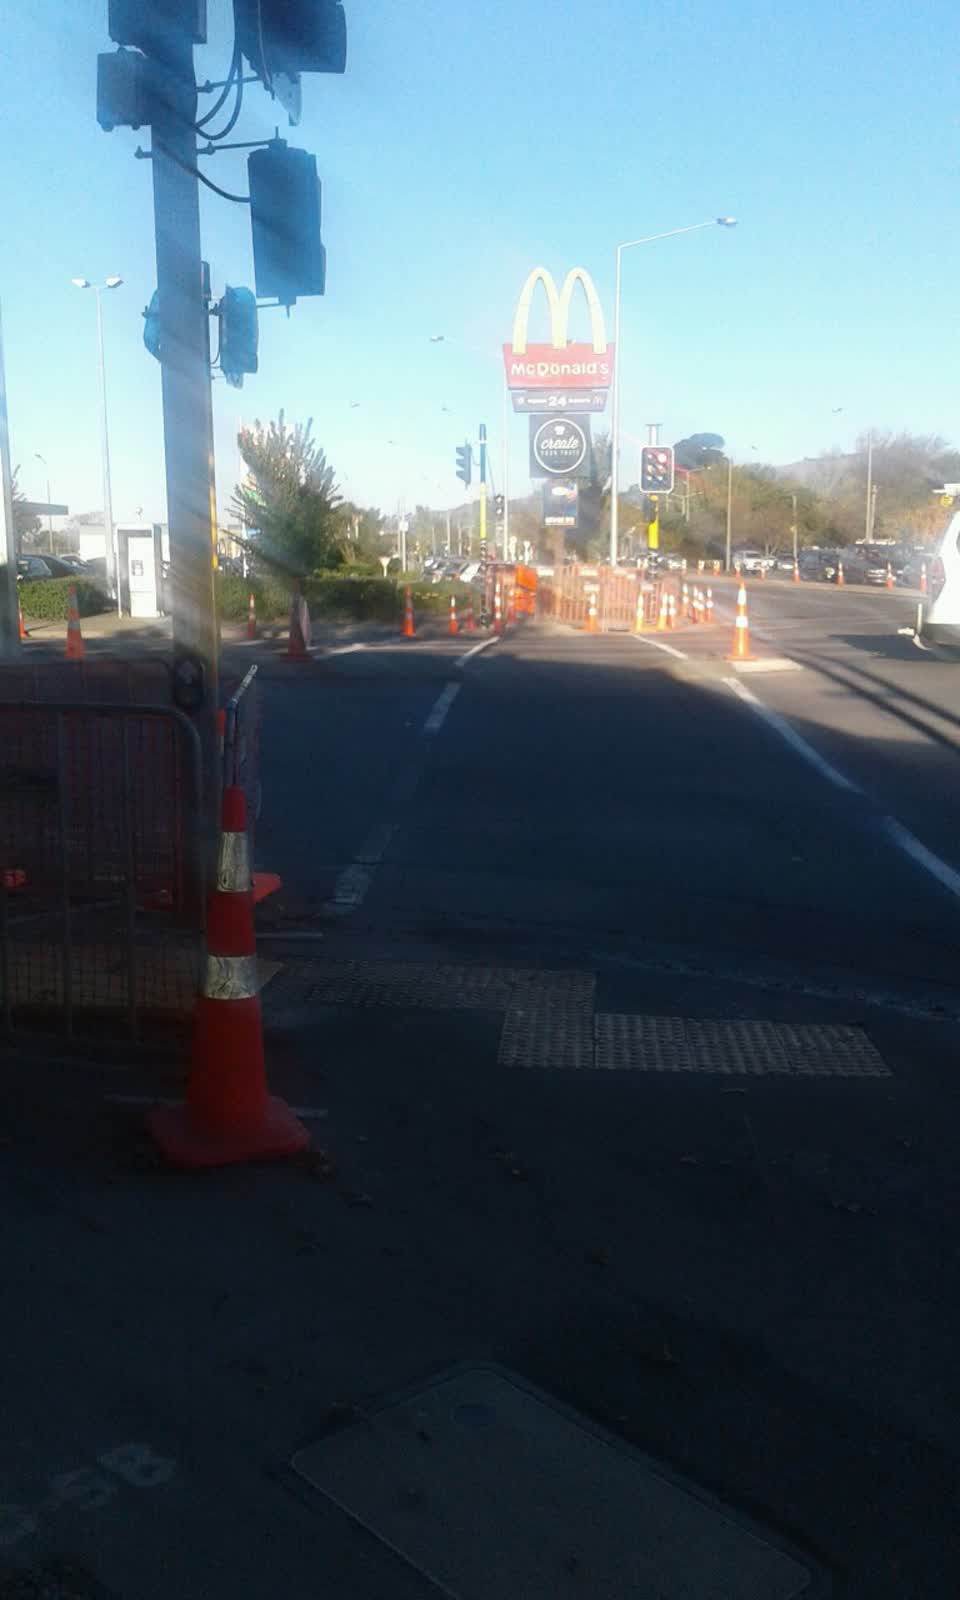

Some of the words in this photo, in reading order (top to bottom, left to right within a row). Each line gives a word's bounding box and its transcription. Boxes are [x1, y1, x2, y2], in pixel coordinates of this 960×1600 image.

[511, 361, 609, 376] McDonald's
[548, 396, 567, 407] 24
[541, 435, 578, 449] create
